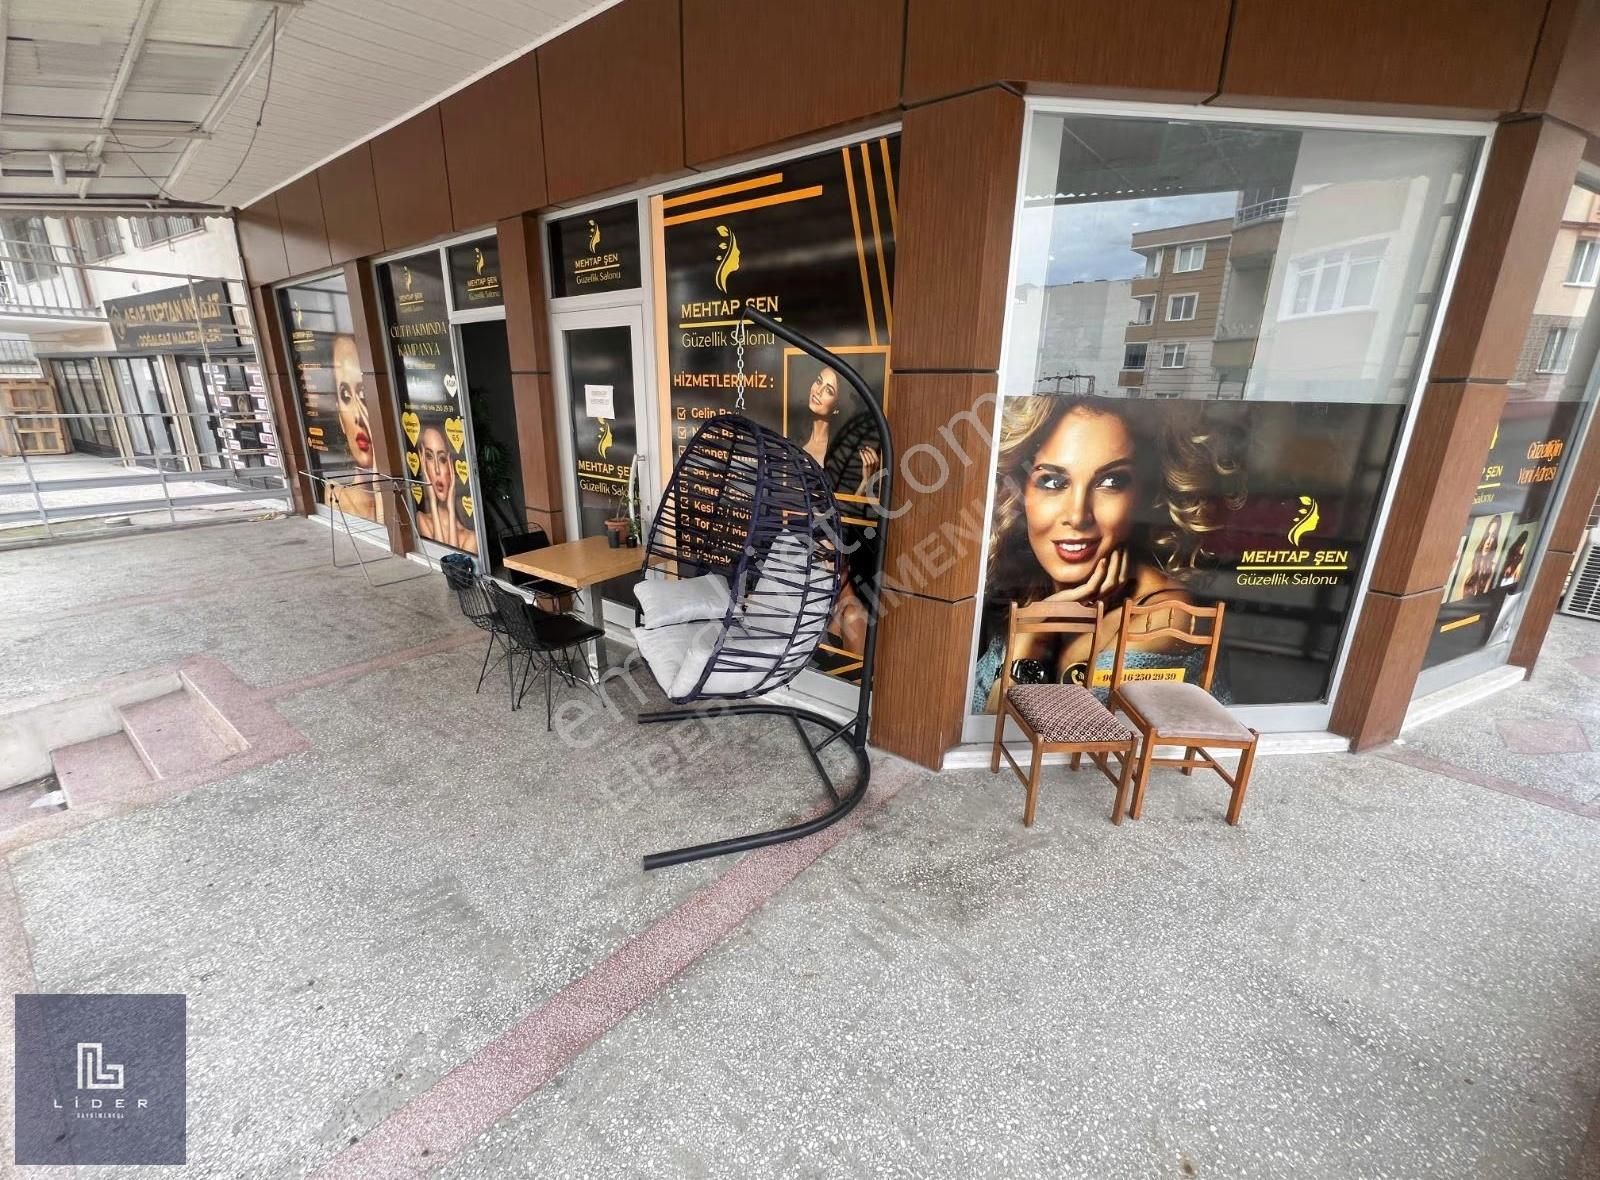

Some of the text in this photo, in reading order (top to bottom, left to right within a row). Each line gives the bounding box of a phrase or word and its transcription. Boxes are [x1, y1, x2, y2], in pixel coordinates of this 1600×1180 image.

[573, 253, 618, 268] MEHTAP ŞEN
[681, 299, 741, 319] MEHTAP
[682, 331, 729, 348] Güzellik
[673, 370, 768, 389] HİZMETLERMİZ
[578, 460, 615, 474] MEHTAP
[1241, 550, 1348, 566] MEHTAP ŞEN
[1236, 573, 1338, 586] Güzellik Salonu
